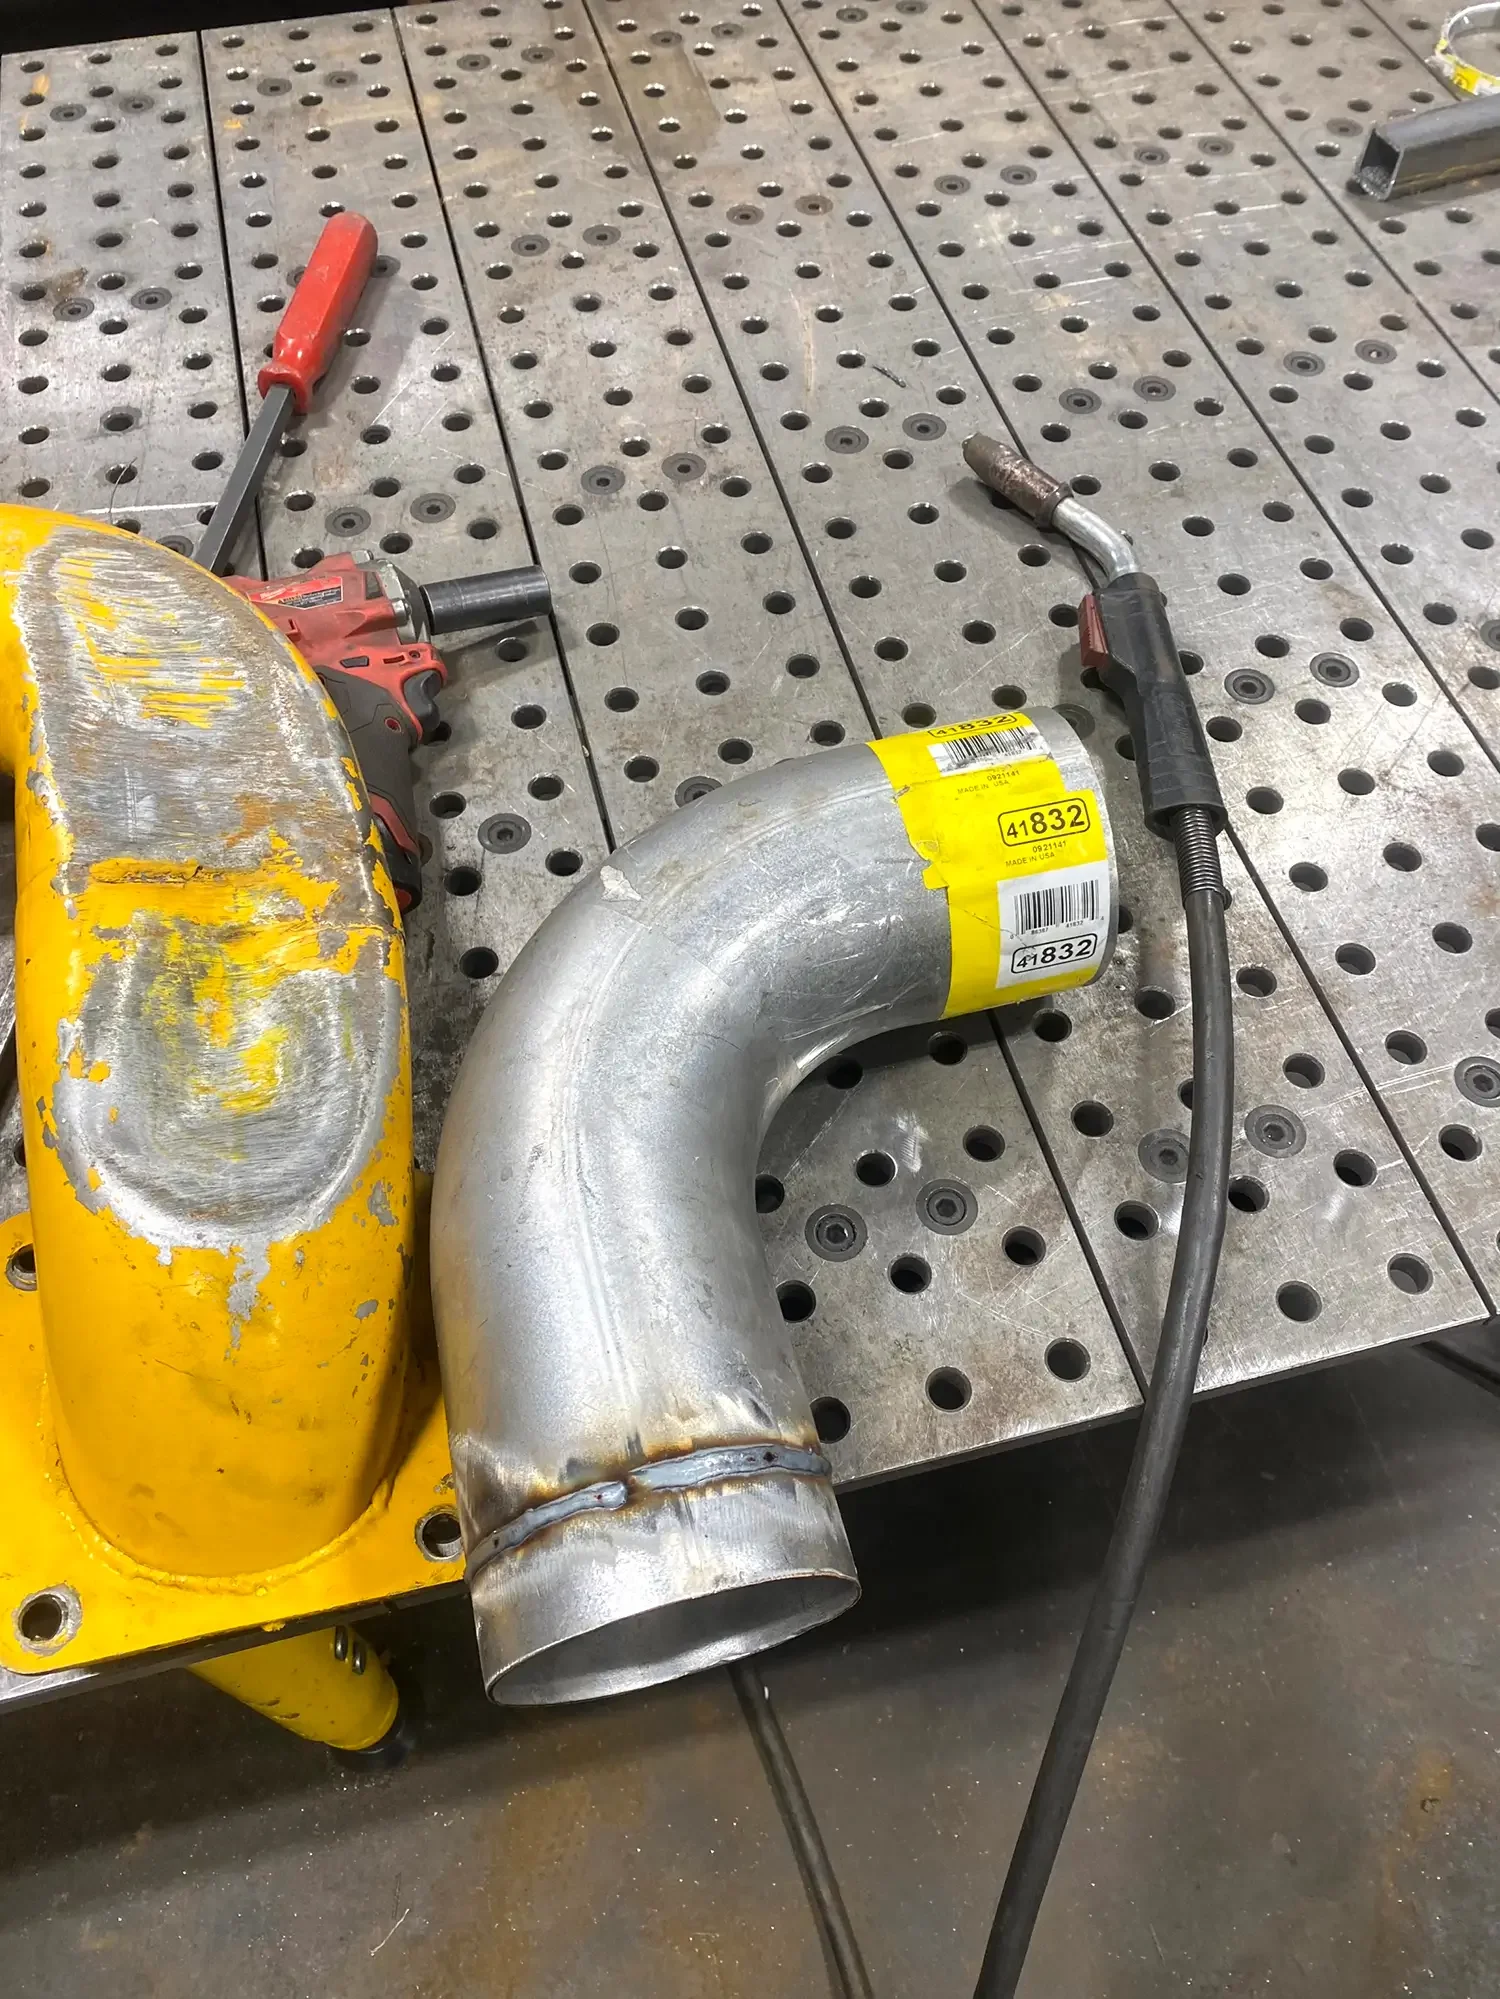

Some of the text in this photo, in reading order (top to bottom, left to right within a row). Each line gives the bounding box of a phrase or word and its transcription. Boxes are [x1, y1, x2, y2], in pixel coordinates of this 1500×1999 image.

[936, 715, 1013, 735] 41832
[987, 770, 1020, 781] 0921141
[957, 785, 979, 794] MADE
[1007, 804, 1085, 838] 41832
[1032, 840, 1067, 853] 0921141
[1005, 857, 1028, 867] MADE
[1039, 852, 1055, 860] USA
[1016, 939, 1092, 968] 41832
